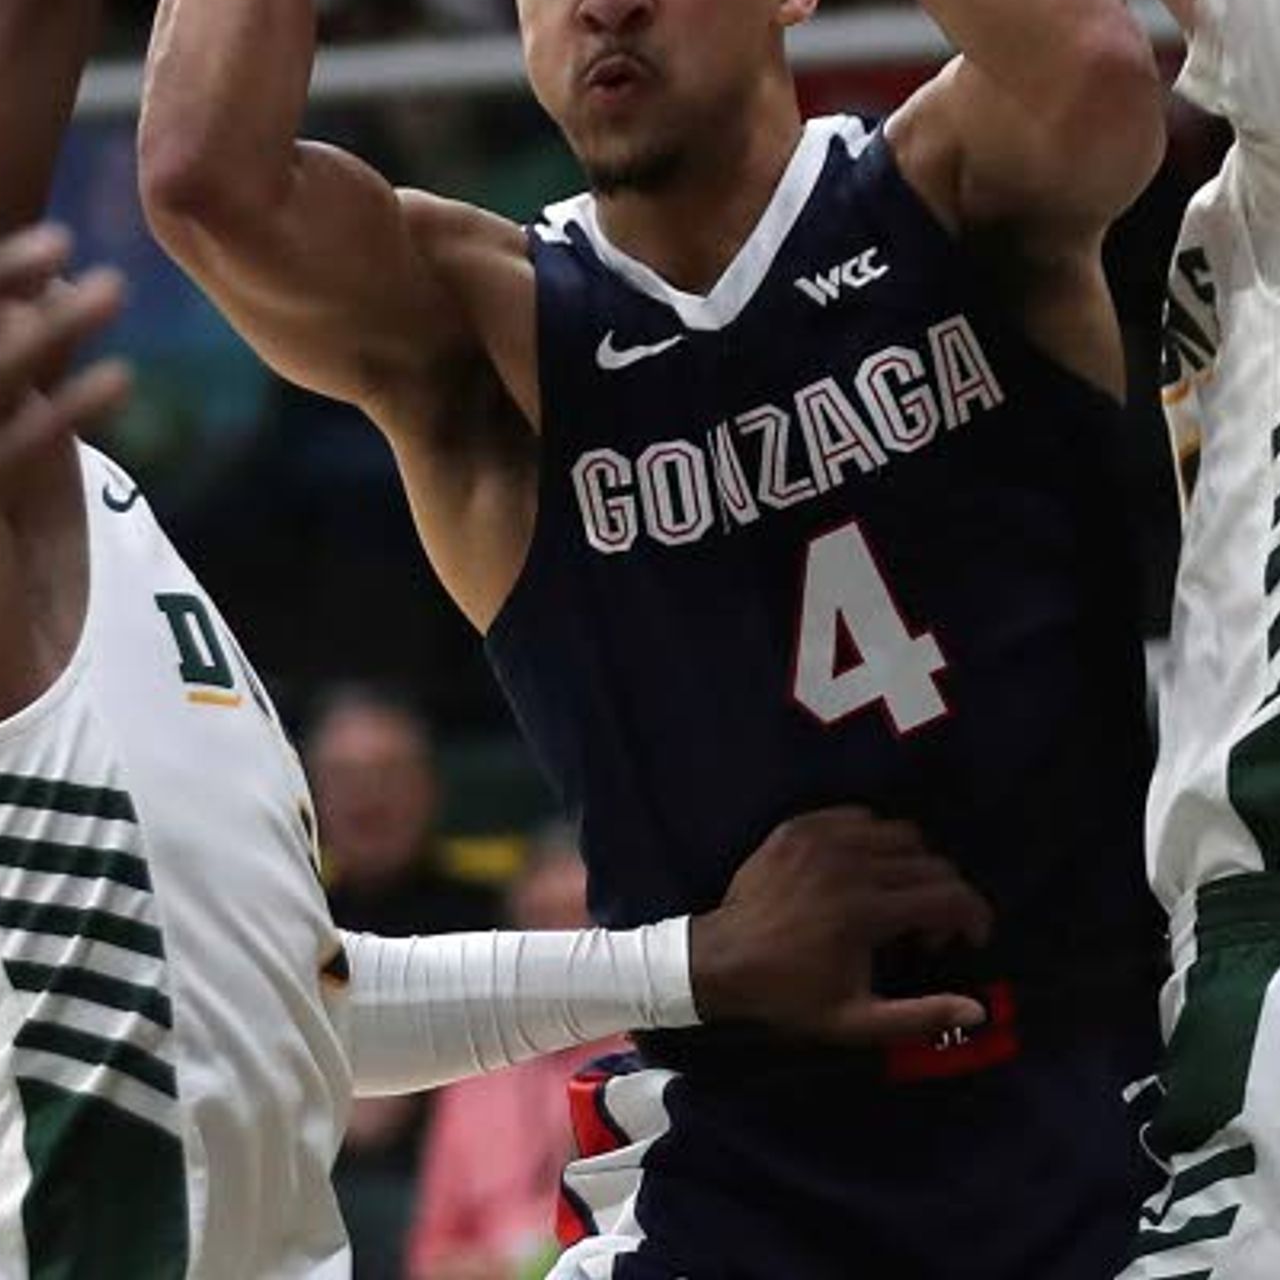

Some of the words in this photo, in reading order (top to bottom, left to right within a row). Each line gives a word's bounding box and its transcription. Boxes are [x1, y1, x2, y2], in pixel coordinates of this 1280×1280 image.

[793, 245, 891, 307] WCC
[570, 313, 1007, 556] GONZAGA
[790, 517, 958, 741] 4
